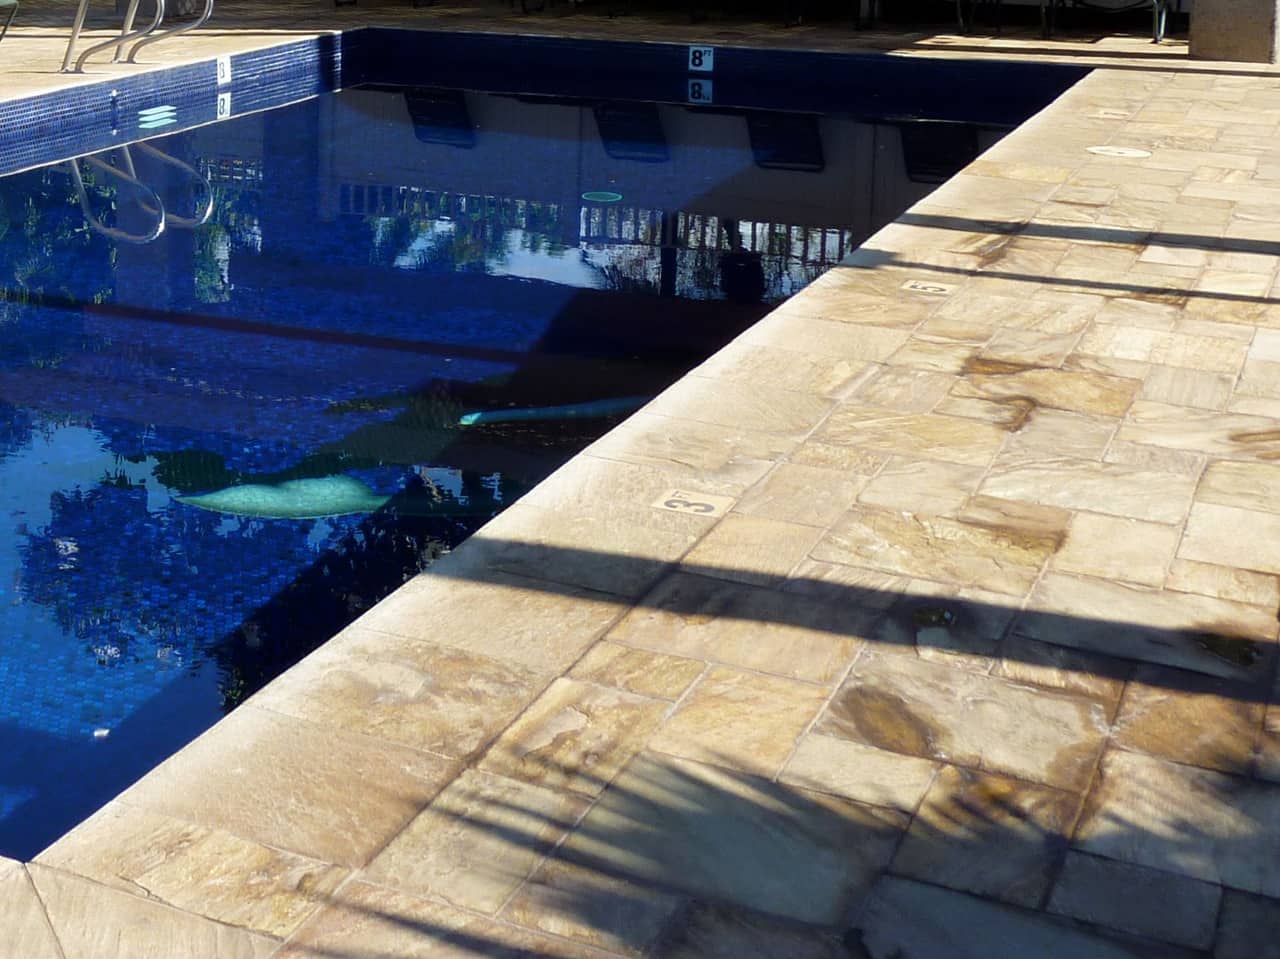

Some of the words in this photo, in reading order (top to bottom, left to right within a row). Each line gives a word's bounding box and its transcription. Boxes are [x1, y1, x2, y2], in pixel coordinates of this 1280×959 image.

[691, 49, 703, 67] 8
[219, 61, 225, 79] 8
[663, 499, 715, 513] 3
